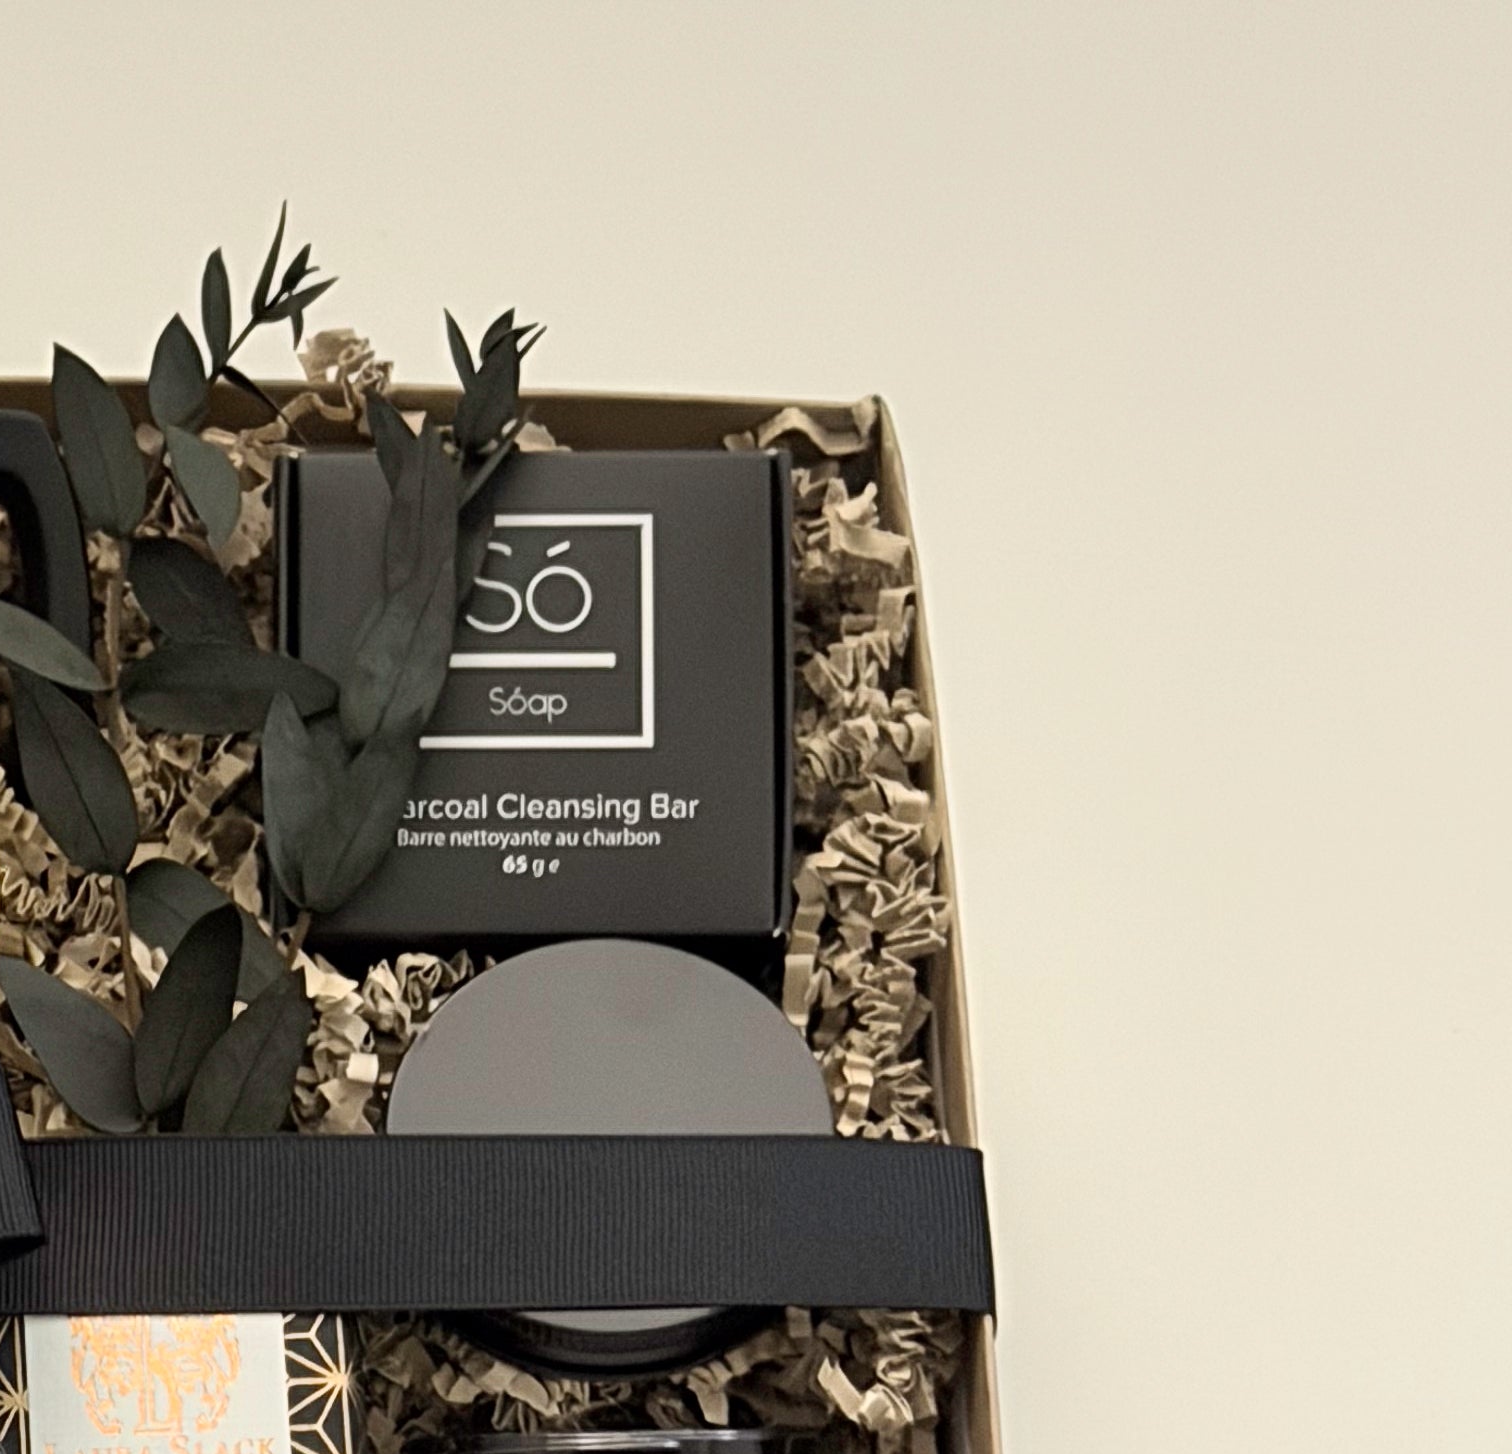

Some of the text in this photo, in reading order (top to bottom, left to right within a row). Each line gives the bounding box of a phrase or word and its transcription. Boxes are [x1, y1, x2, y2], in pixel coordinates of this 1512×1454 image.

[465, 540, 592, 633] Só
[488, 686, 568, 723] Sóap
[402, 793, 700, 825] arcoal Cleansing Bar
[397, 827, 662, 849] Barre nettoyante au charbon
[502, 854, 528, 874] 65
